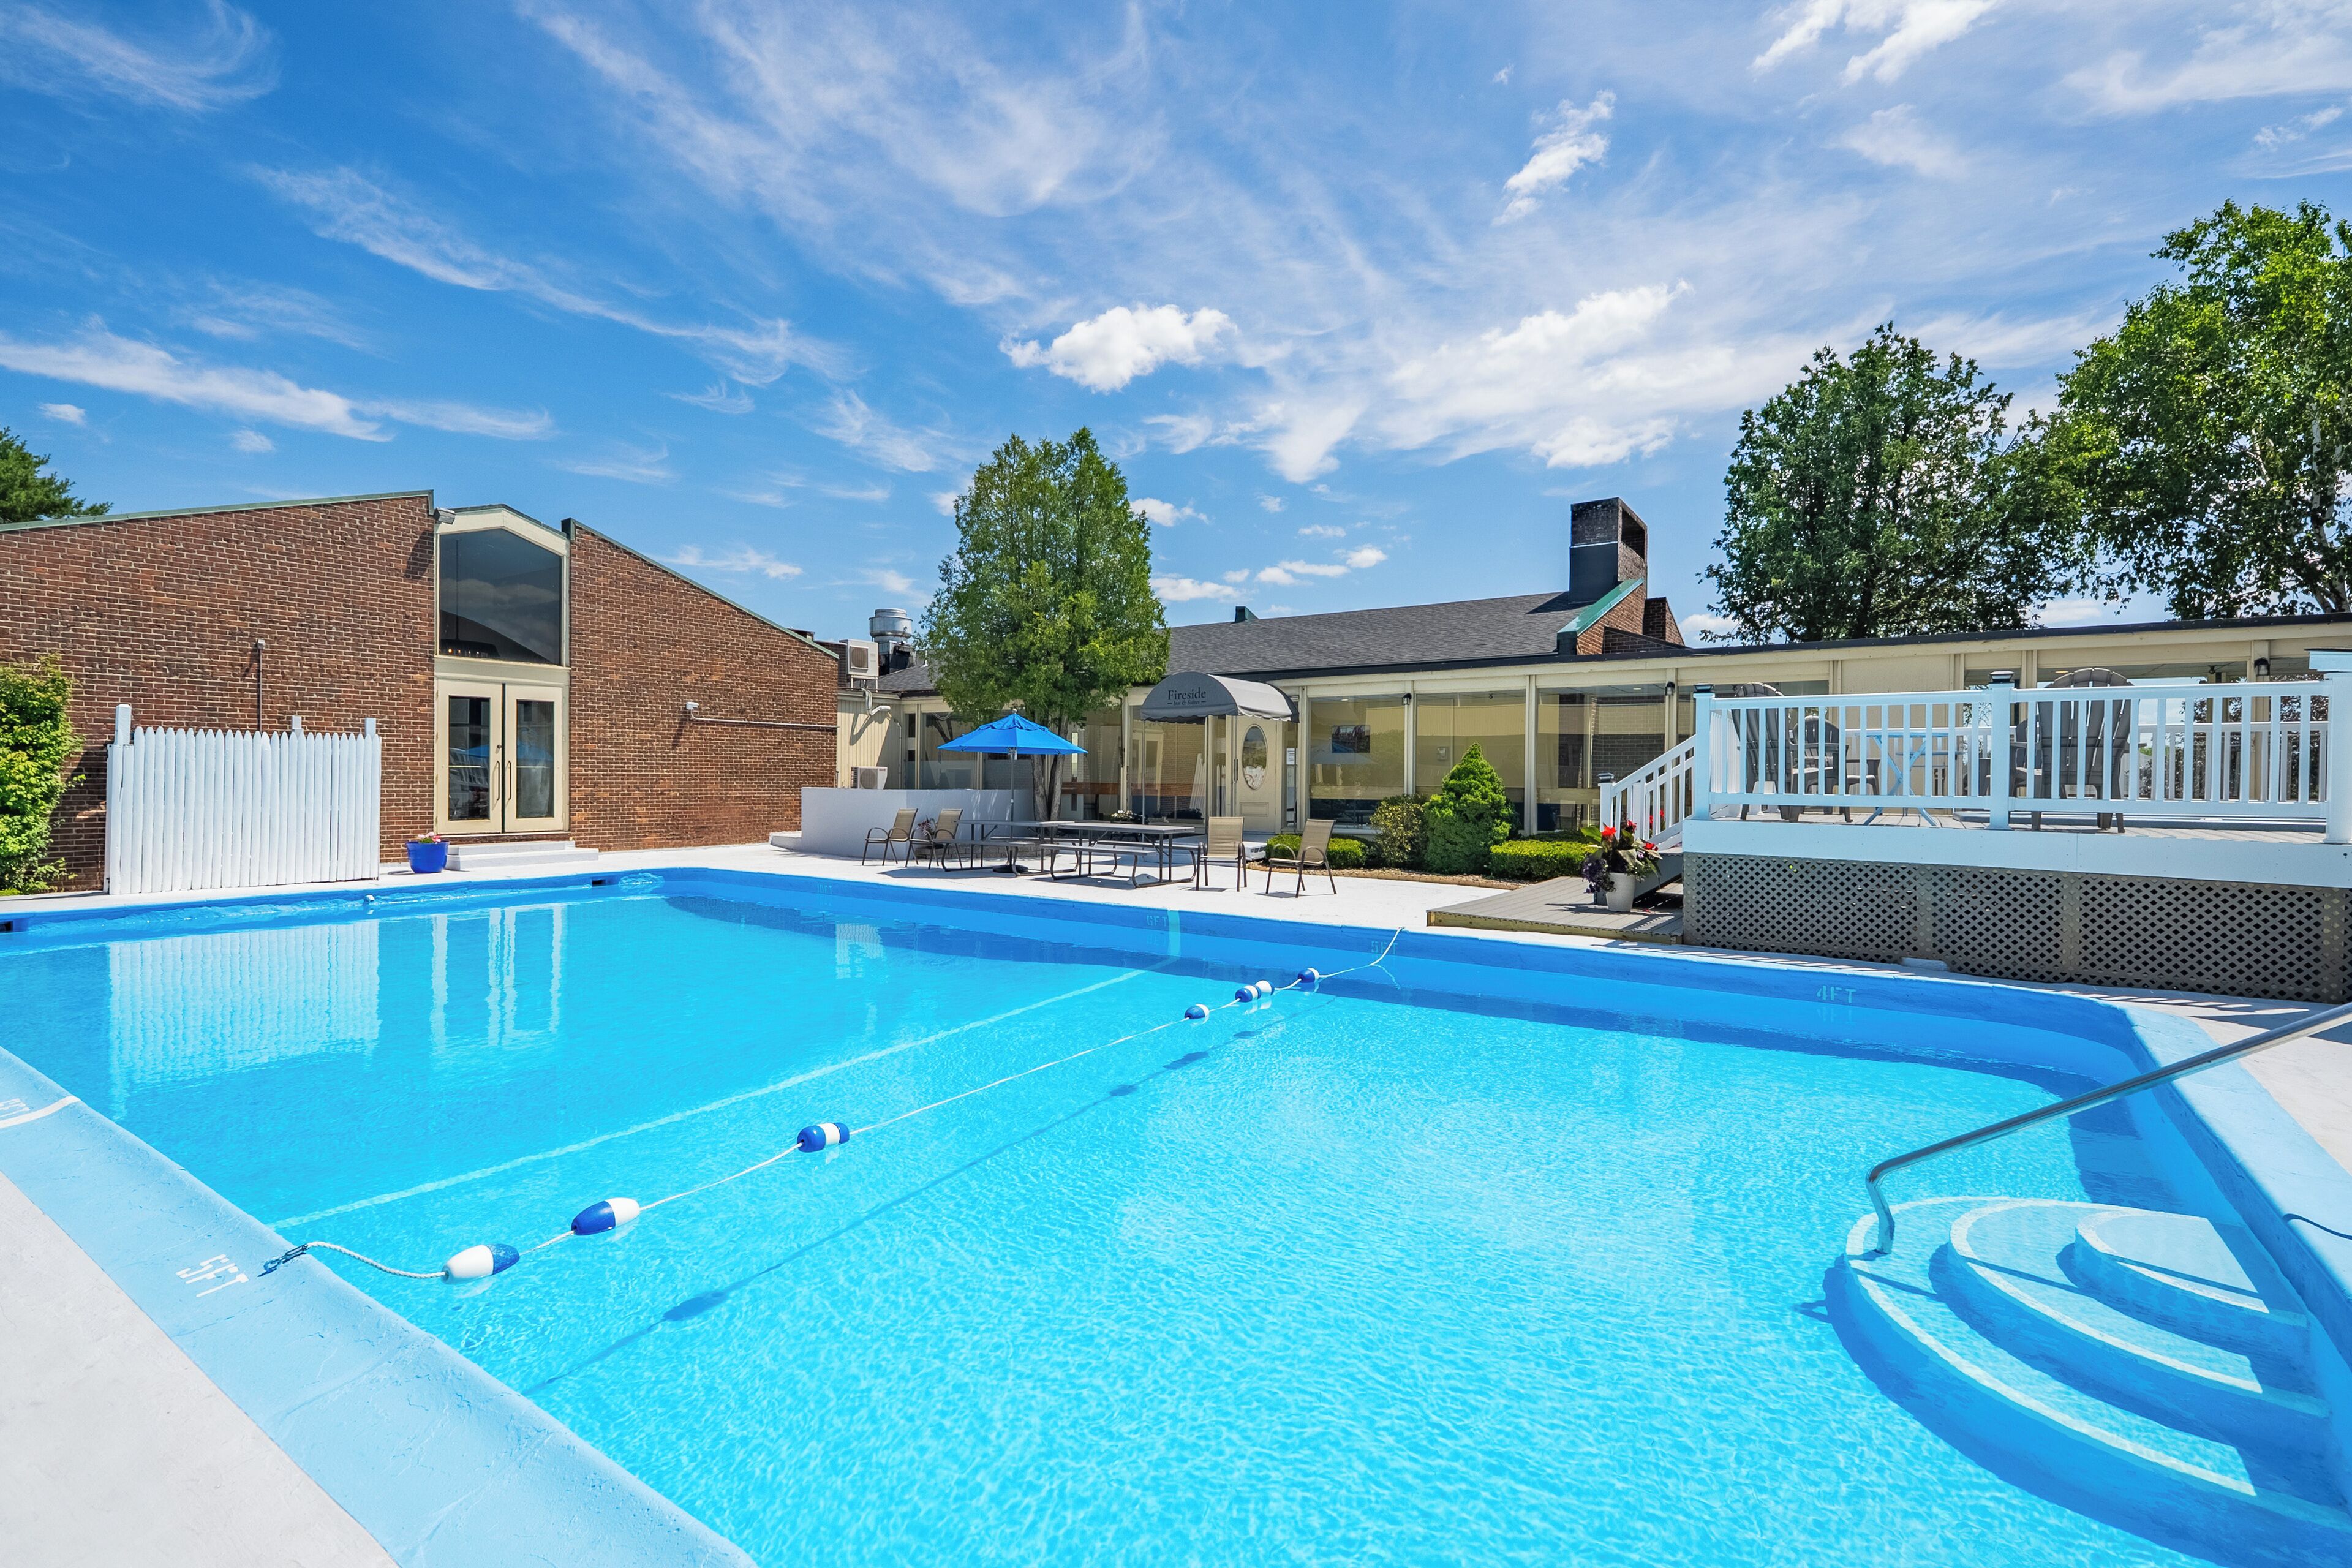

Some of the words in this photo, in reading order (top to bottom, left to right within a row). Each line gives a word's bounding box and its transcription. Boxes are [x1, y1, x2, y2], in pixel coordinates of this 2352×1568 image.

[1168, 687, 1206, 700] Fireside
[1817, 985, 1856, 1003] 4FT
[175, 1254, 249, 1298] 5FT
